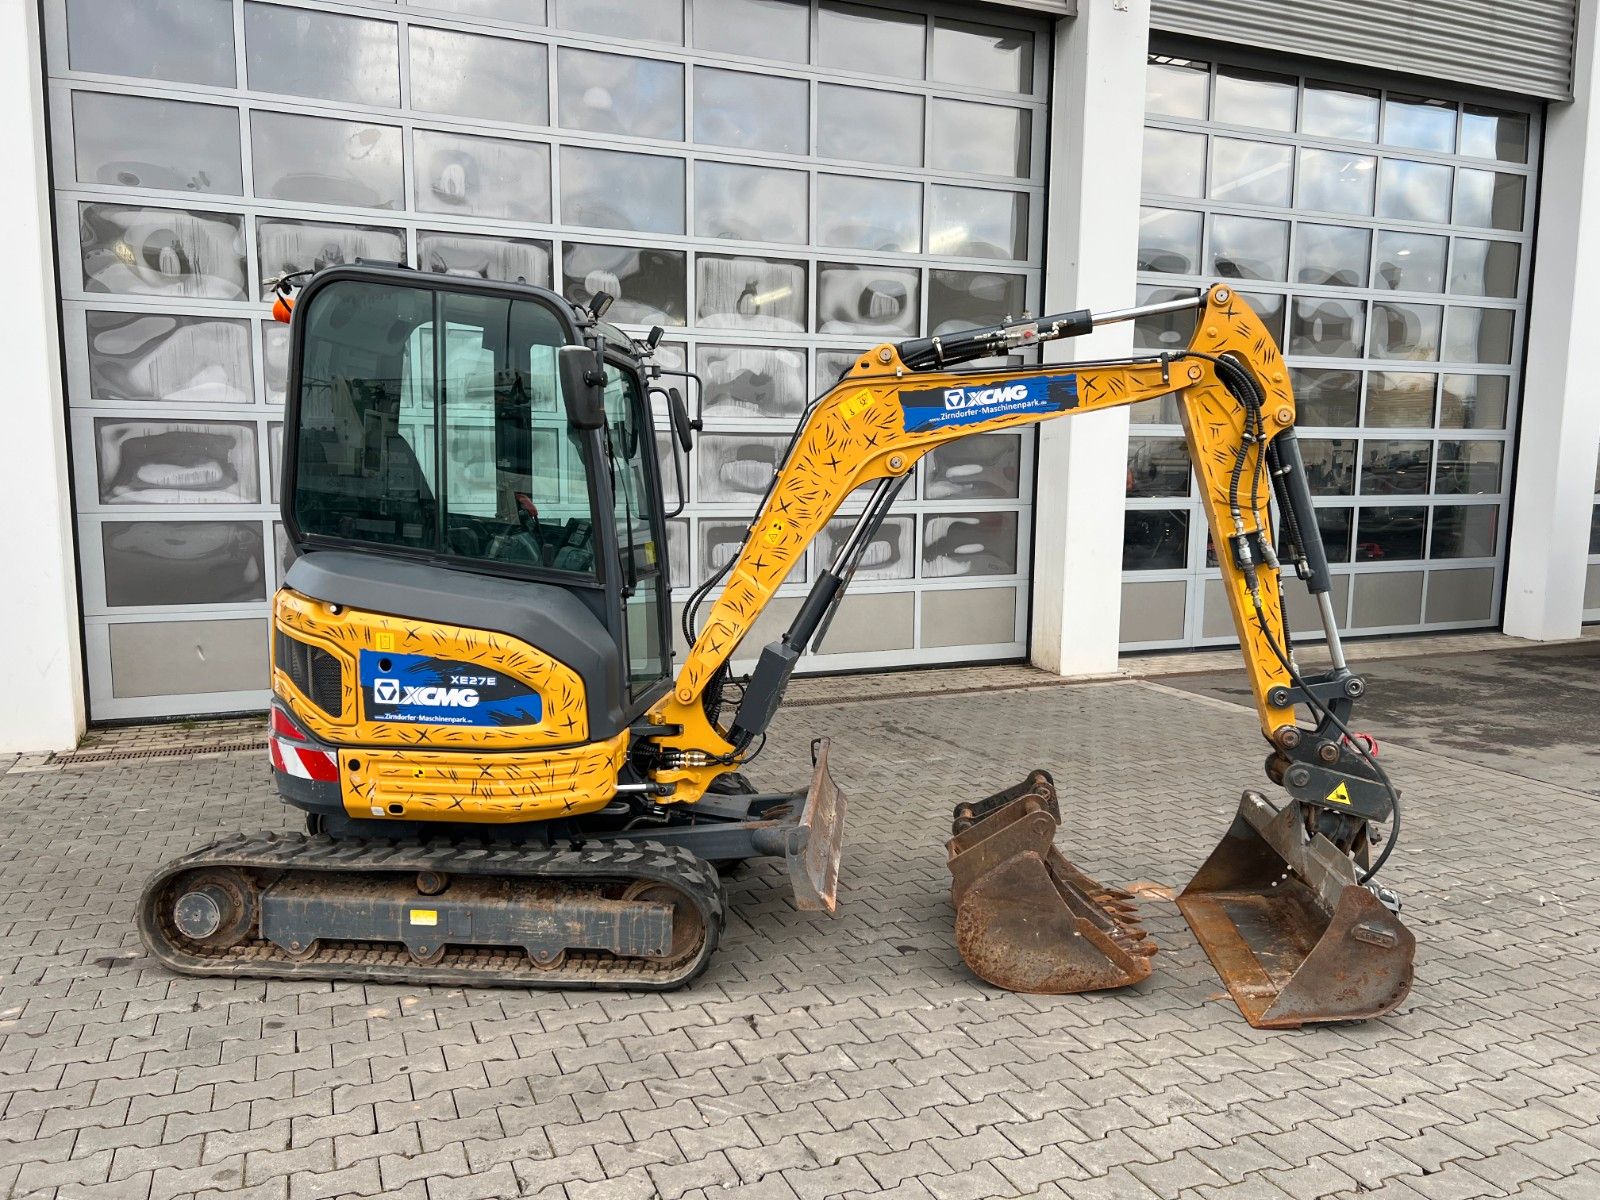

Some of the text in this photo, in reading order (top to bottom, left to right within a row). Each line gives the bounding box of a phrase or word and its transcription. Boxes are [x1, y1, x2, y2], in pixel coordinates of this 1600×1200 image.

[967, 385, 1028, 407] XCMG
[450, 675, 496, 686] XE27E
[399, 686, 480, 707] XCMG
